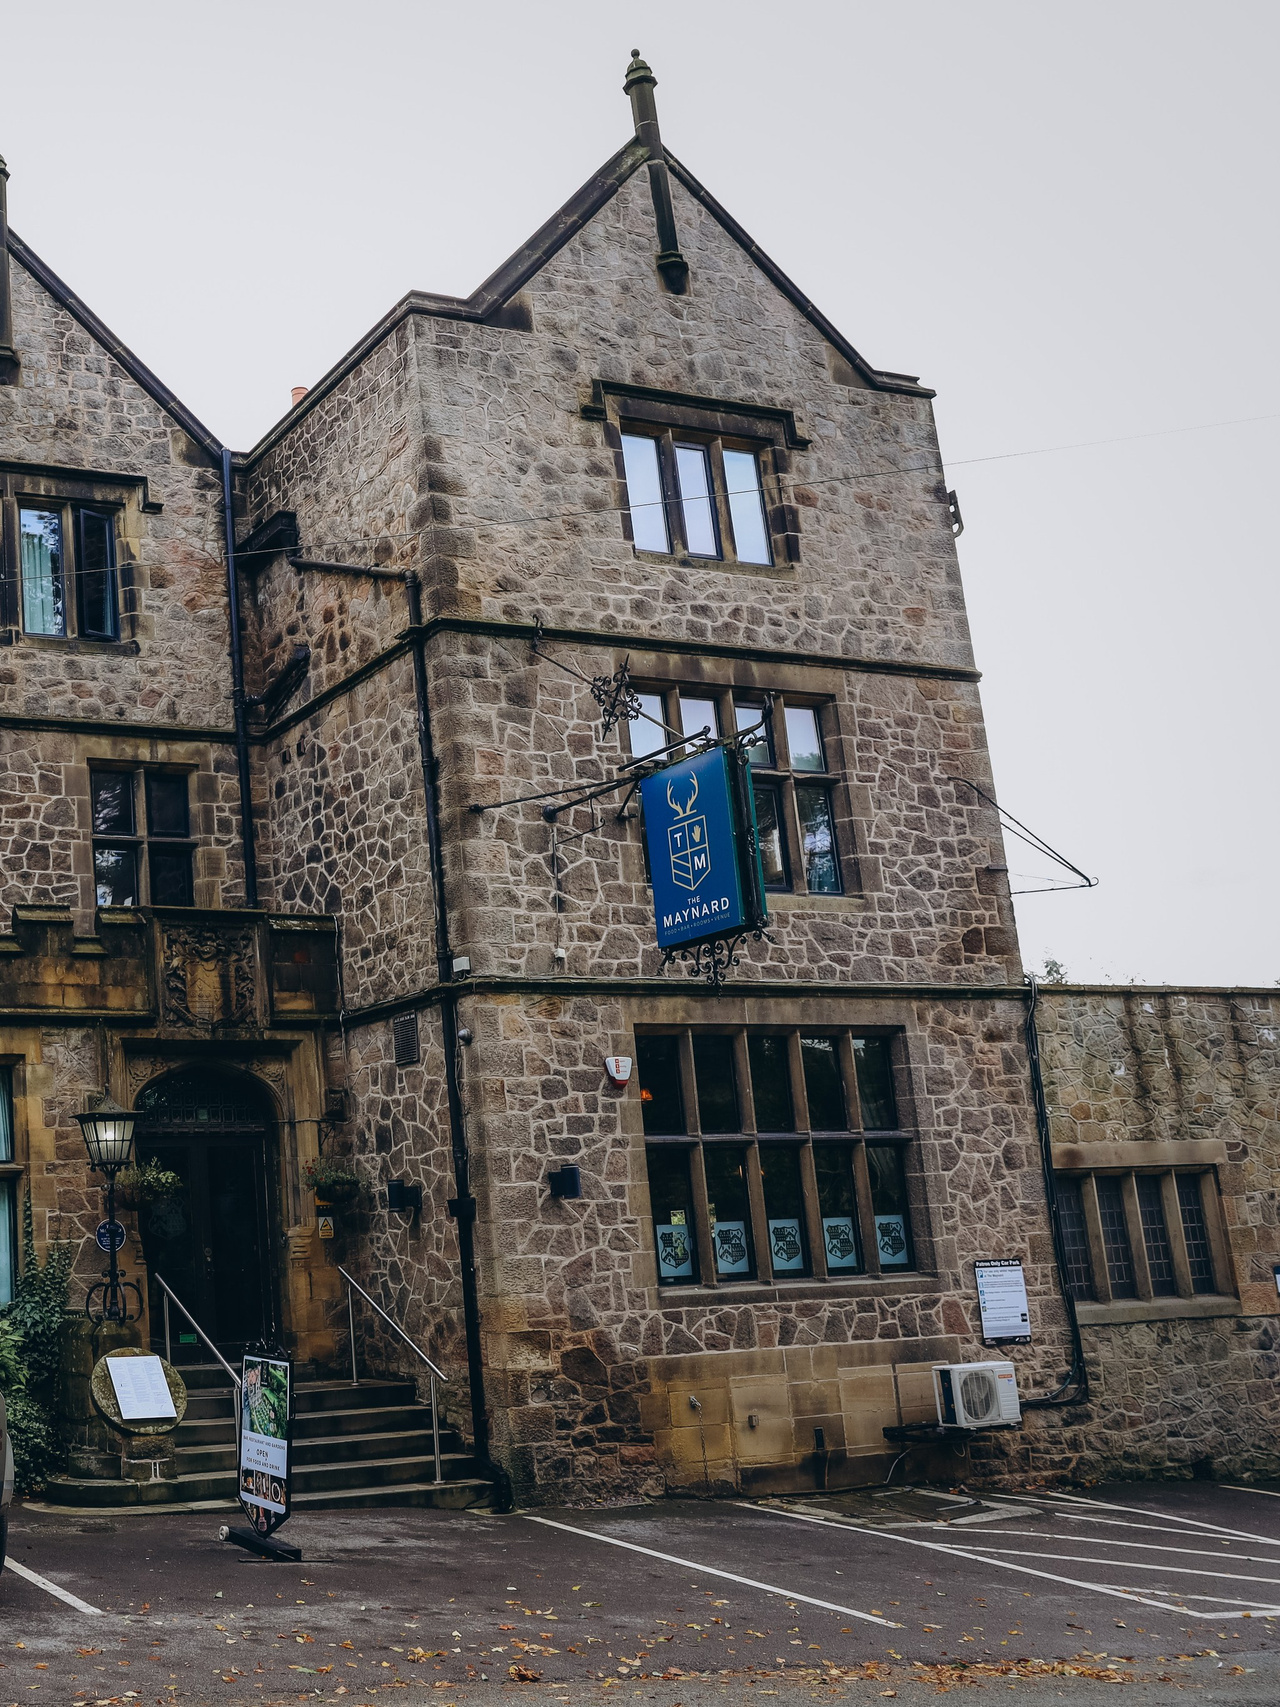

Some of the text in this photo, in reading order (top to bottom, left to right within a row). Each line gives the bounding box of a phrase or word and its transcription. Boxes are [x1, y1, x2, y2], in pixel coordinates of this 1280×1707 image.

[673, 832, 683, 848] T
[694, 854, 706, 871] M
[687, 895, 701, 905] THE
[663, 897, 729, 928] MAYNARD
[665, 928, 677, 936] FOOD
[693, 918, 710, 927] ROOMS
[714, 912, 730, 921] VENUE
[256, 1449, 268, 1458] OPEN
